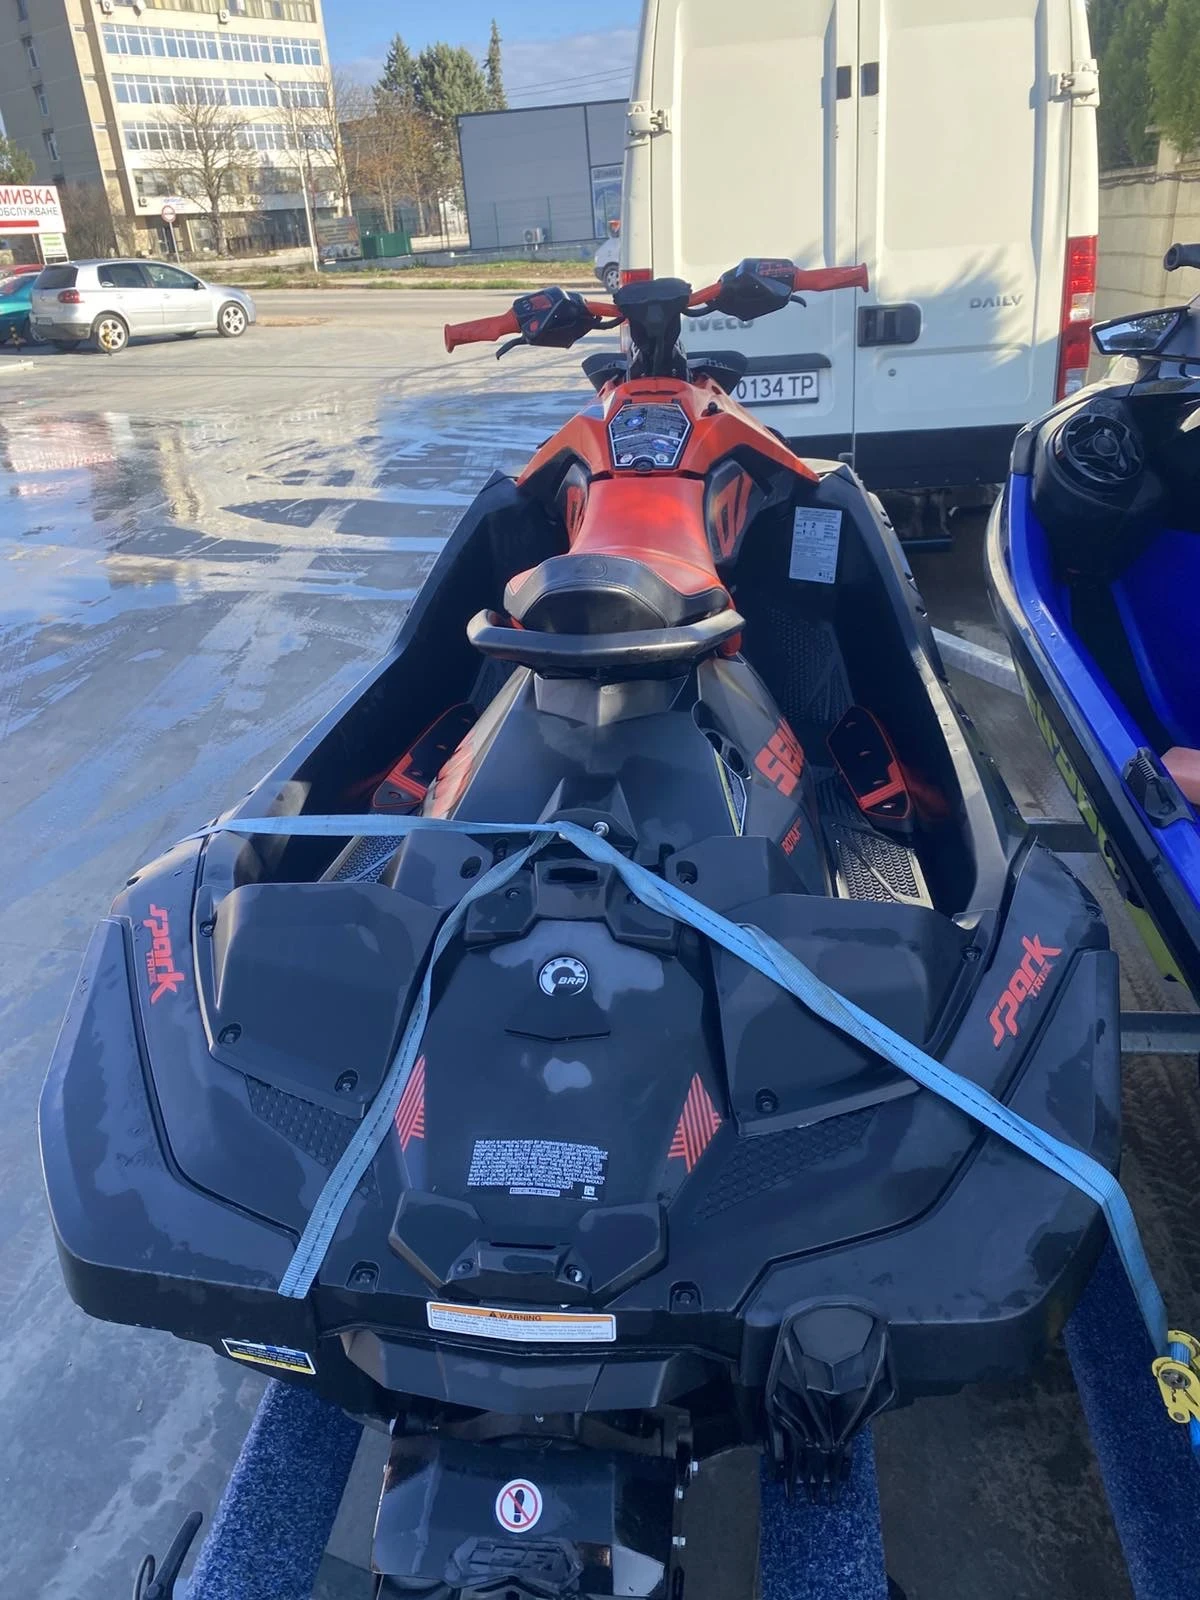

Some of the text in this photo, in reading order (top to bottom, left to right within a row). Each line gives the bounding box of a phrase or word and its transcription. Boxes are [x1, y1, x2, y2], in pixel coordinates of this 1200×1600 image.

[970, 294, 1023, 309] DAILY
[737, 376, 784, 400] 0134
[558, 976, 585, 985] BRP
[499, 1313, 542, 1322] WARNING
